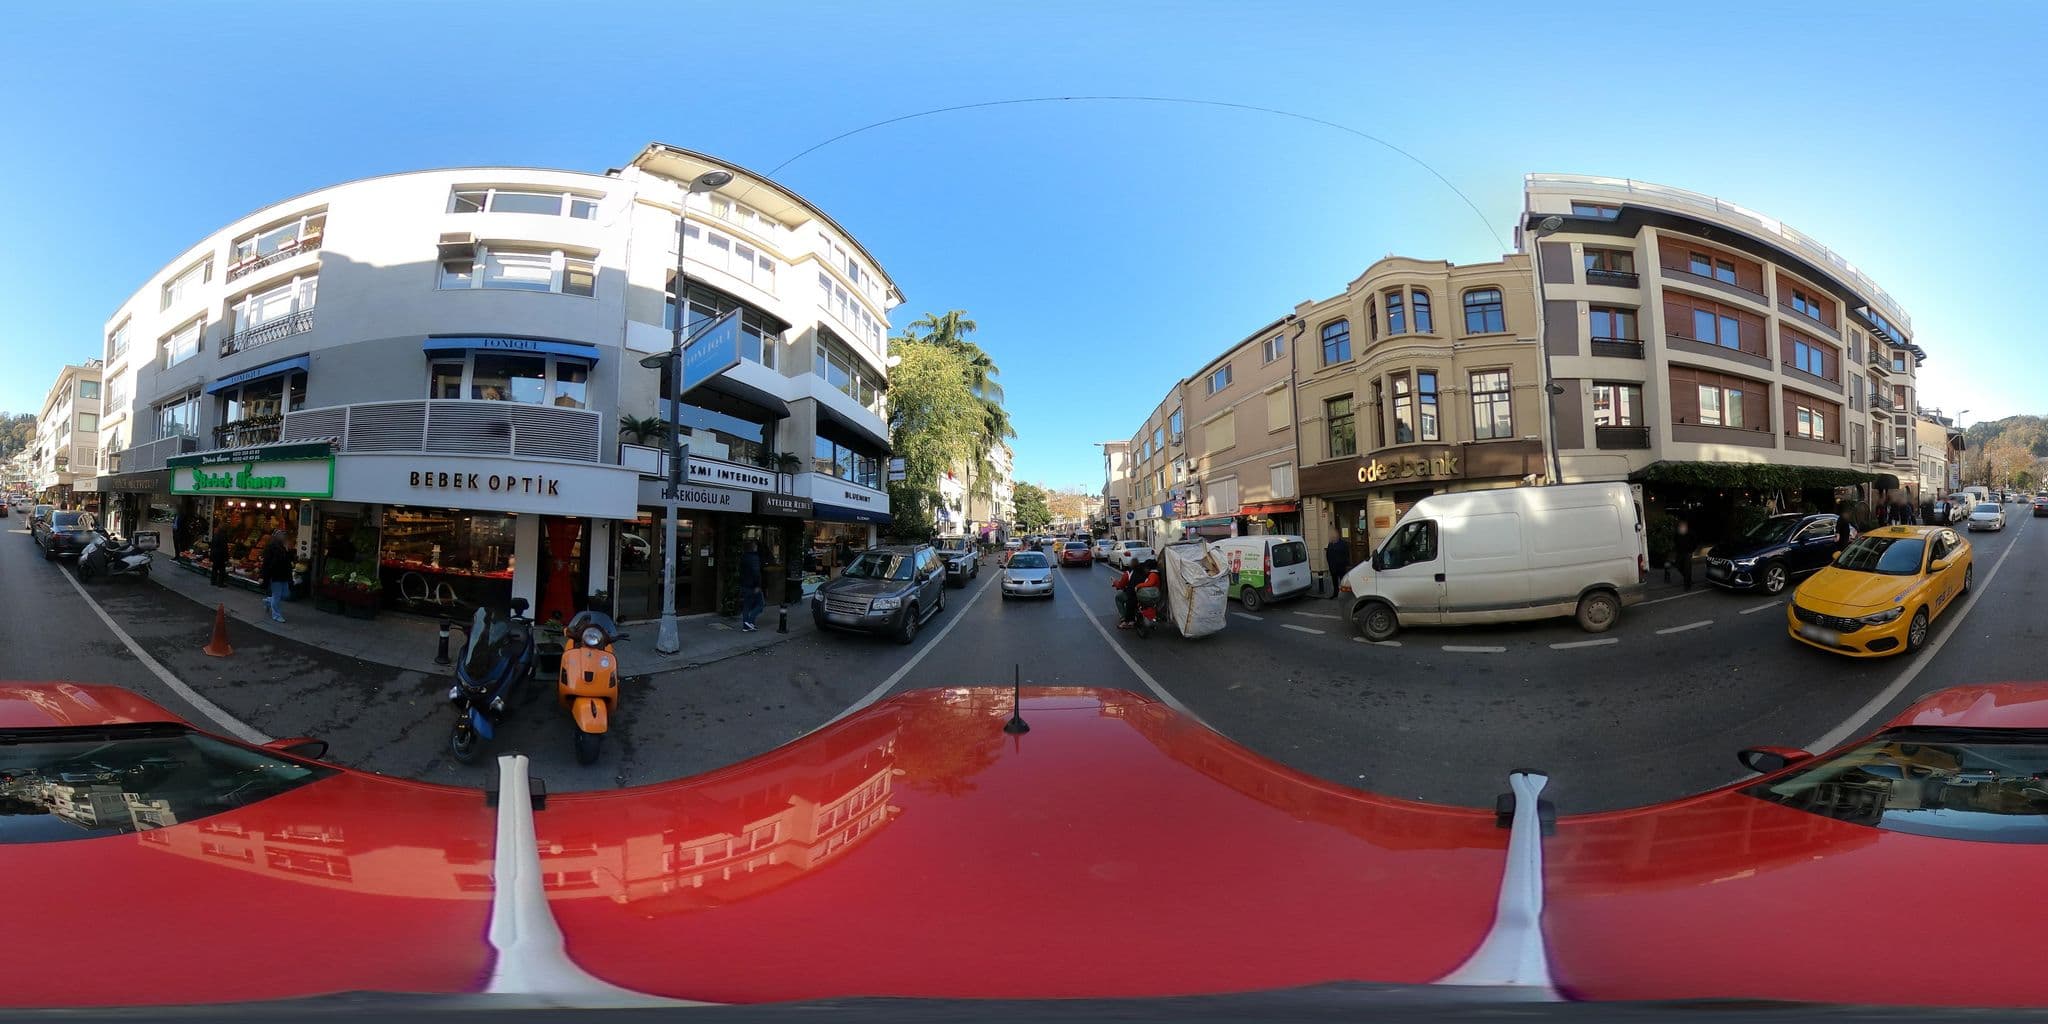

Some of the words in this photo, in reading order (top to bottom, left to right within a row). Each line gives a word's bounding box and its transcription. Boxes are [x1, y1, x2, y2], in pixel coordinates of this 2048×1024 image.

[690, 464, 711, 476] XMI
[717, 469, 769, 486] INTERIORS
[1358, 450, 1459, 482] odeabank
[410, 471, 479, 489] BEBEK
[488, 475, 559, 495] OPTİK
[661, 487, 718, 505] HSEKİOĞLU
